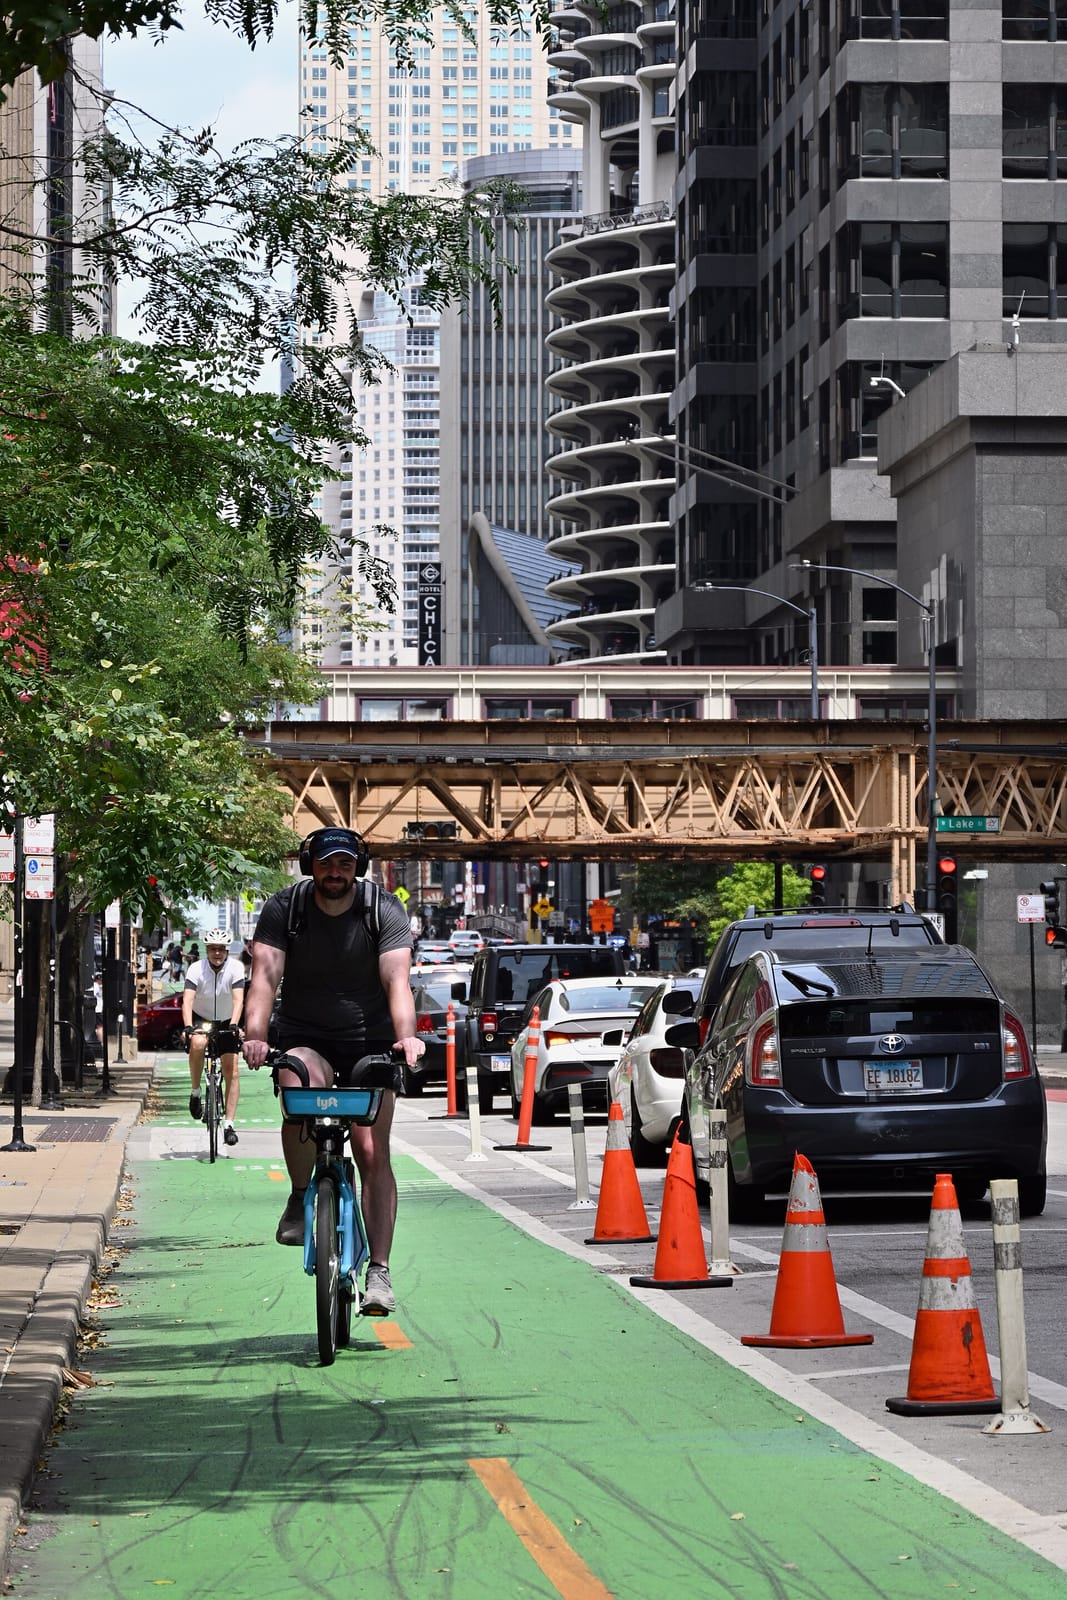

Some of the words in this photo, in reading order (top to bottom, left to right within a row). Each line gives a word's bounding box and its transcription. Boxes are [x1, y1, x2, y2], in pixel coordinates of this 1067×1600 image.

[949, 819, 974, 828] Lake
[867, 1070, 881, 1084] EE
[316, 1096, 338, 1110] lyft
